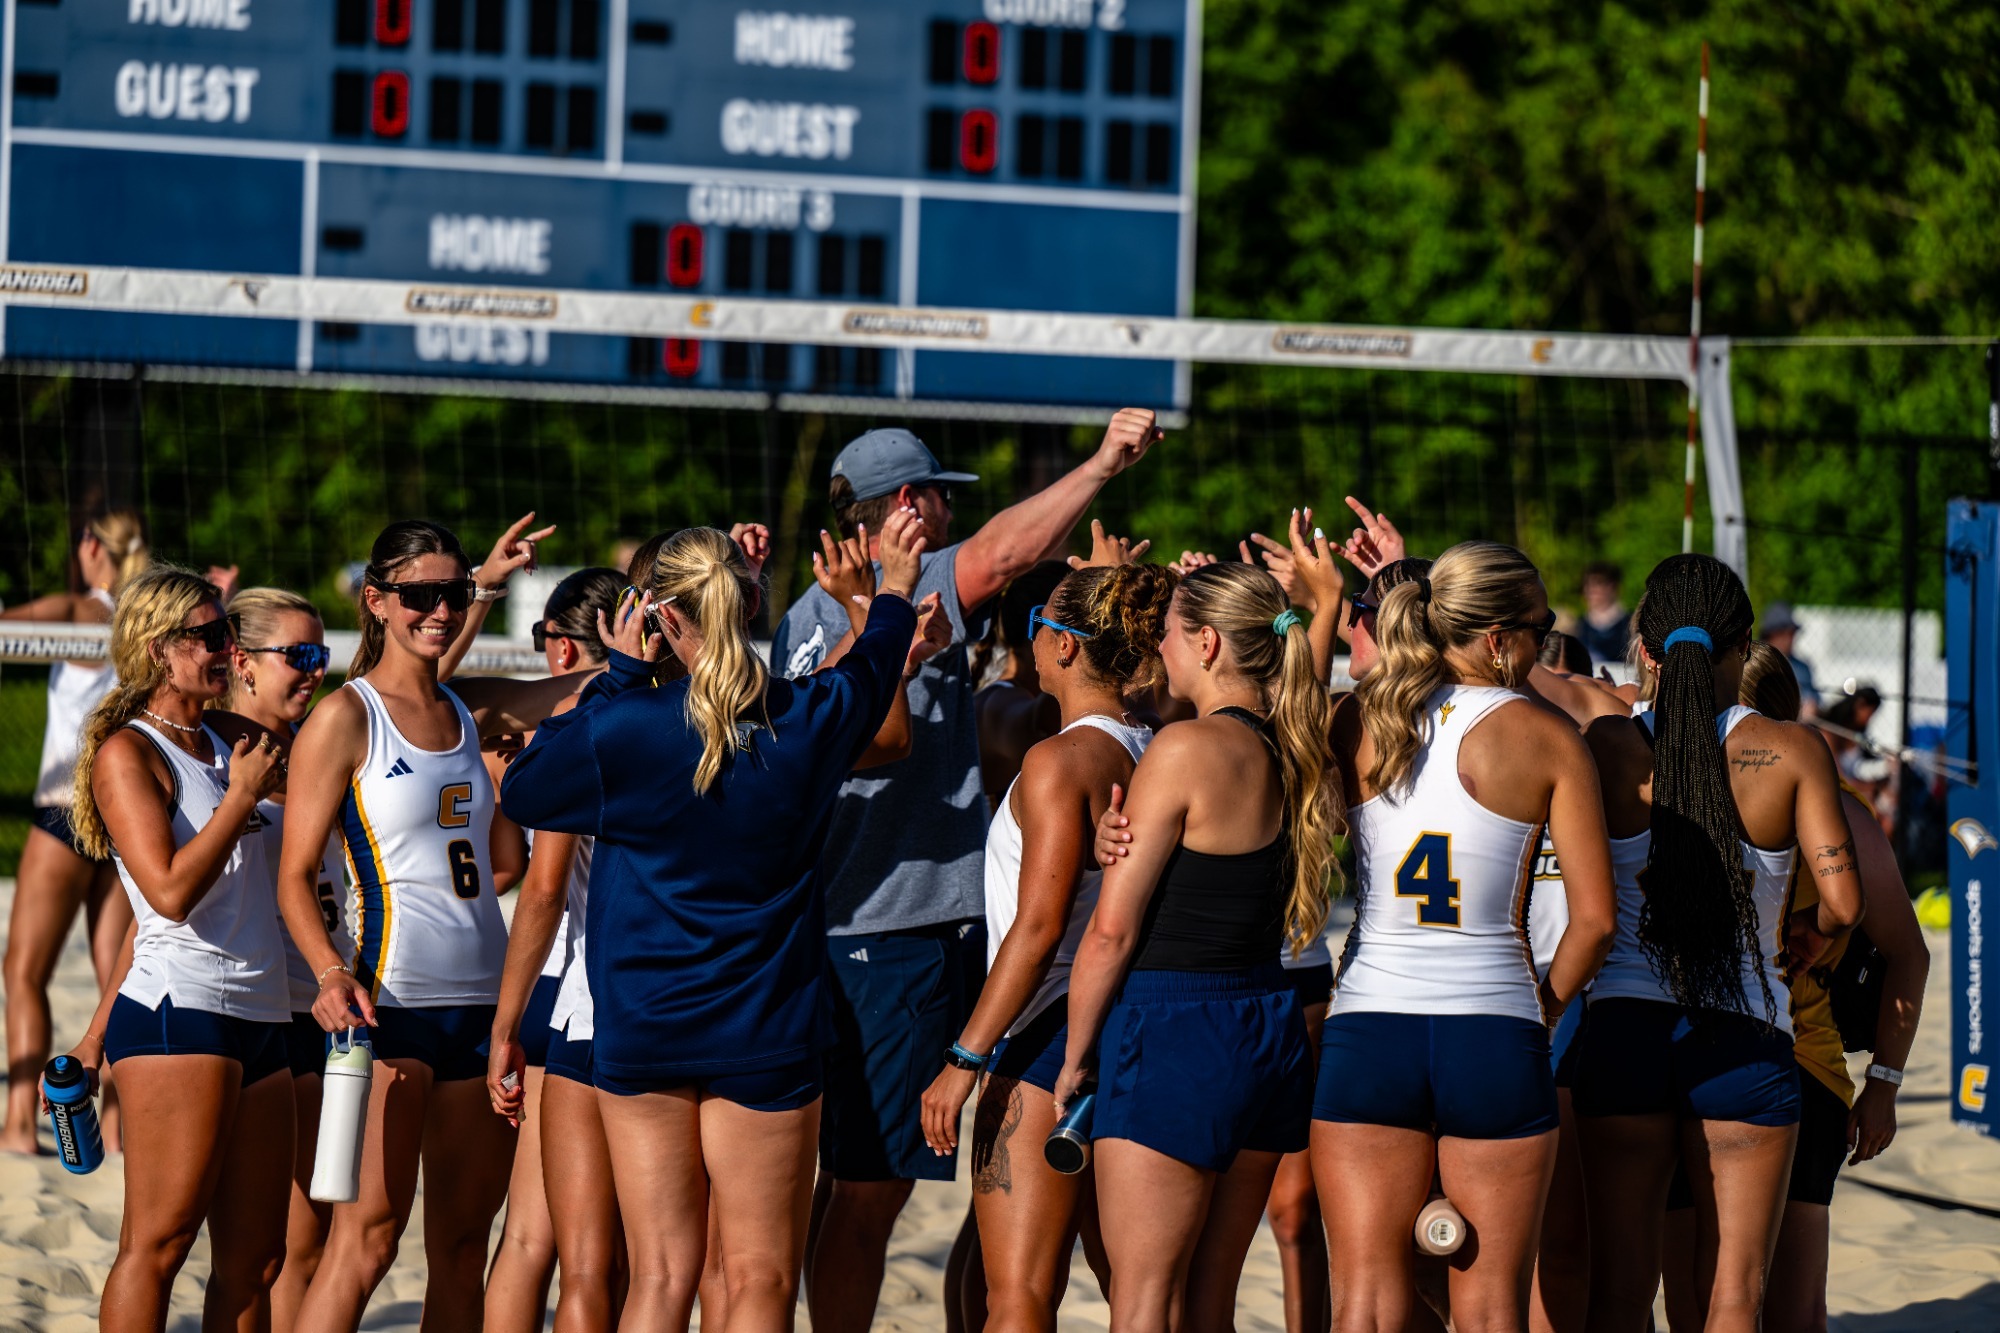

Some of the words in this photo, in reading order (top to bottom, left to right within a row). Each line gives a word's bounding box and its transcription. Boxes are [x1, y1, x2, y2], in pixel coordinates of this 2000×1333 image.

[734, 10, 856, 71] HOME
[963, 20, 1000, 85] 0
[114, 59, 260, 124] GUEST
[371, 70, 411, 137] 0
[720, 97, 861, 161] GUEST
[960, 108, 998, 174] 0
[688, 183, 800, 231] COURT
[804, 190, 836, 232] 3
[429, 213, 552, 276] HOME
[666, 222, 705, 288] 0
[414, 320, 550, 367] GUEST
[446, 838, 480, 899] 6
[1394, 831, 1462, 928] 4
[1966, 879, 1983, 958] sports
[1966, 959, 1983, 1055] imports
[1959, 1062, 1990, 1113] C
[53, 1103, 78, 1164] POWERADE
